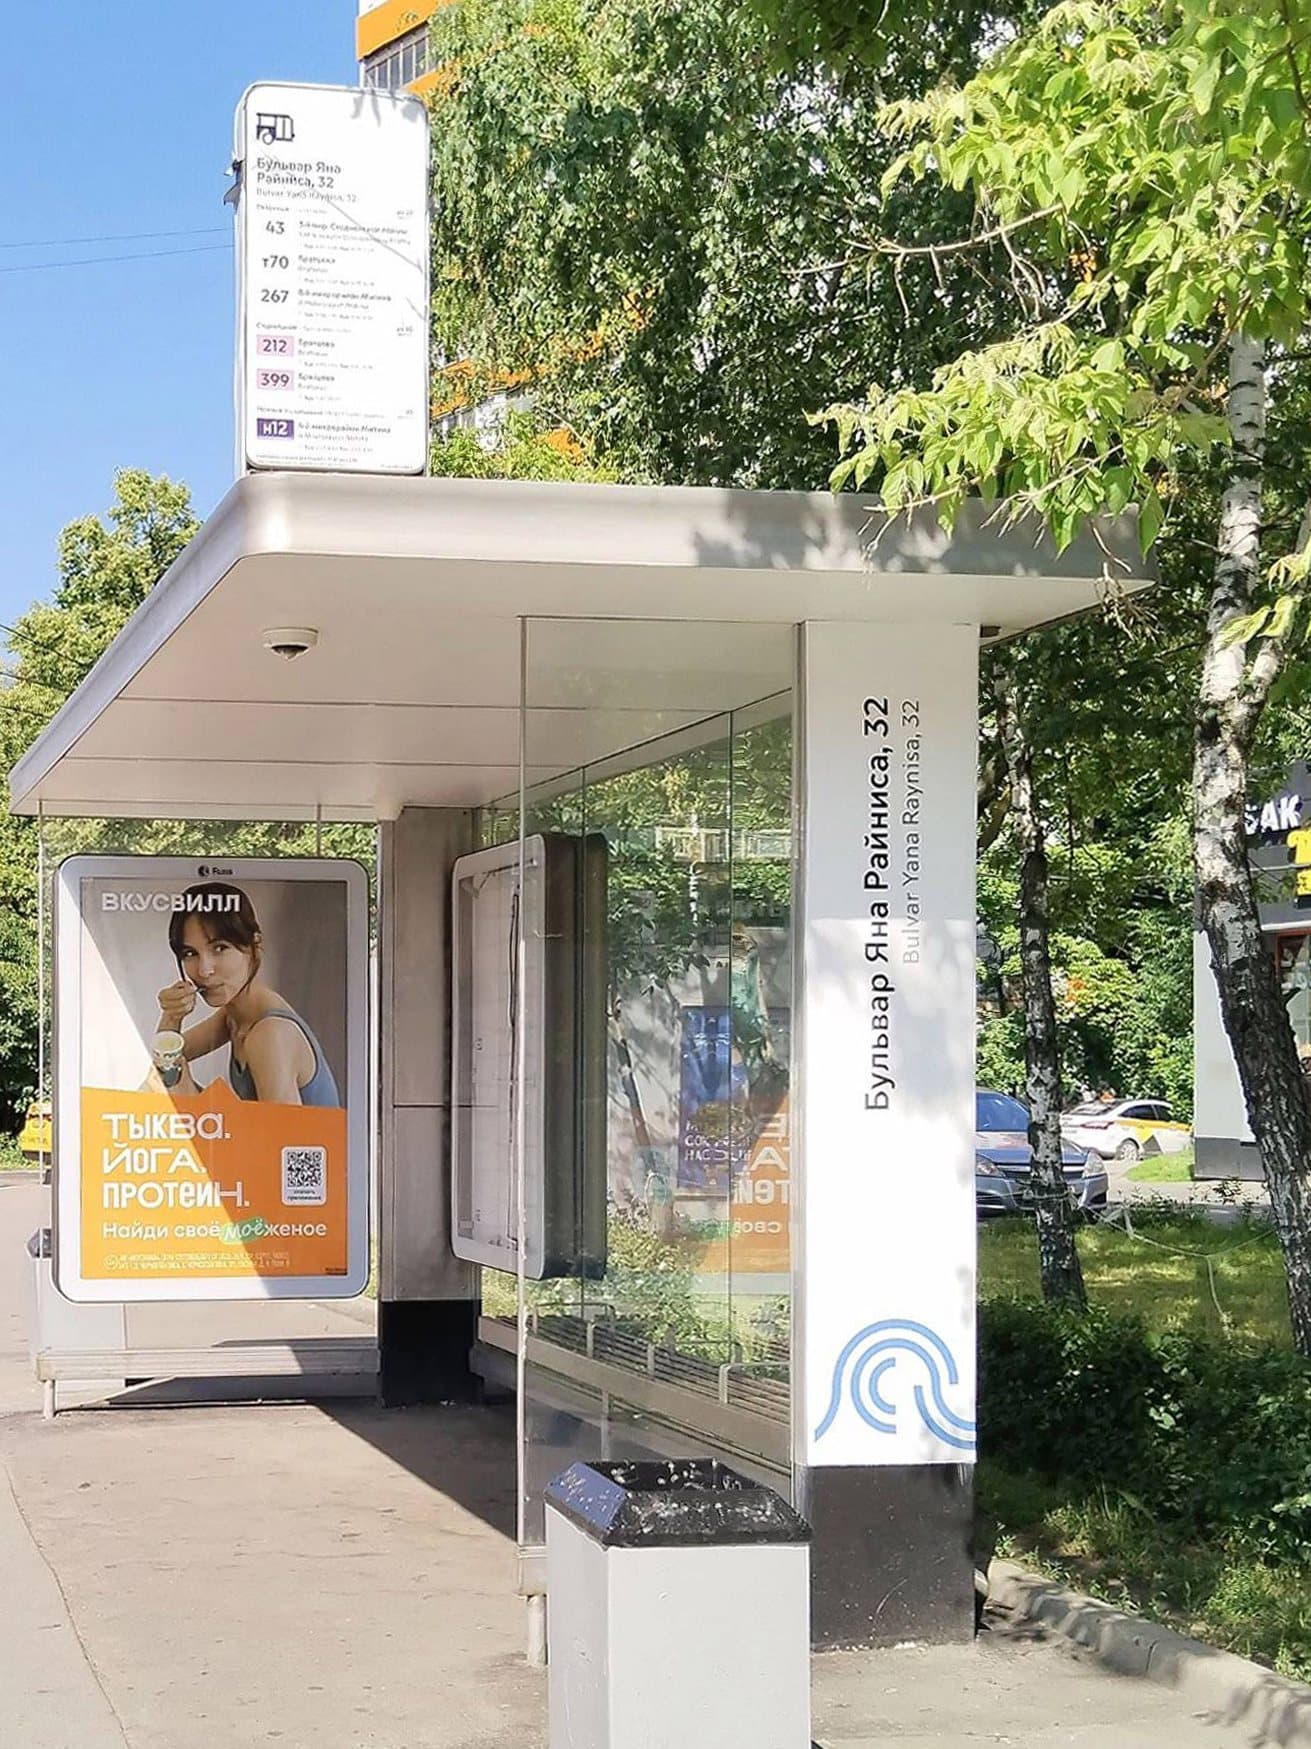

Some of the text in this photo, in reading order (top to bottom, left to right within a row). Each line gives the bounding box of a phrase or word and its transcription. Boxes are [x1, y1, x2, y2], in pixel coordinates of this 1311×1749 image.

[318, 176, 335, 189] 32
[266, 220, 286, 235] 43
[261, 288, 289, 304] 267
[263, 339, 288, 353] 212
[261, 373, 290, 387] 399
[901, 700, 924, 964] Bulvar Yana Raynisa, 32
[101, 892, 241, 913] ВКУСВИЛЛ
[863, 698, 896, 1110] Бульвар Яна Райниса, 32
[102, 1142, 208, 1174] ЙОГА.
[103, 1217, 328, 1242] Найди своё моёженое
